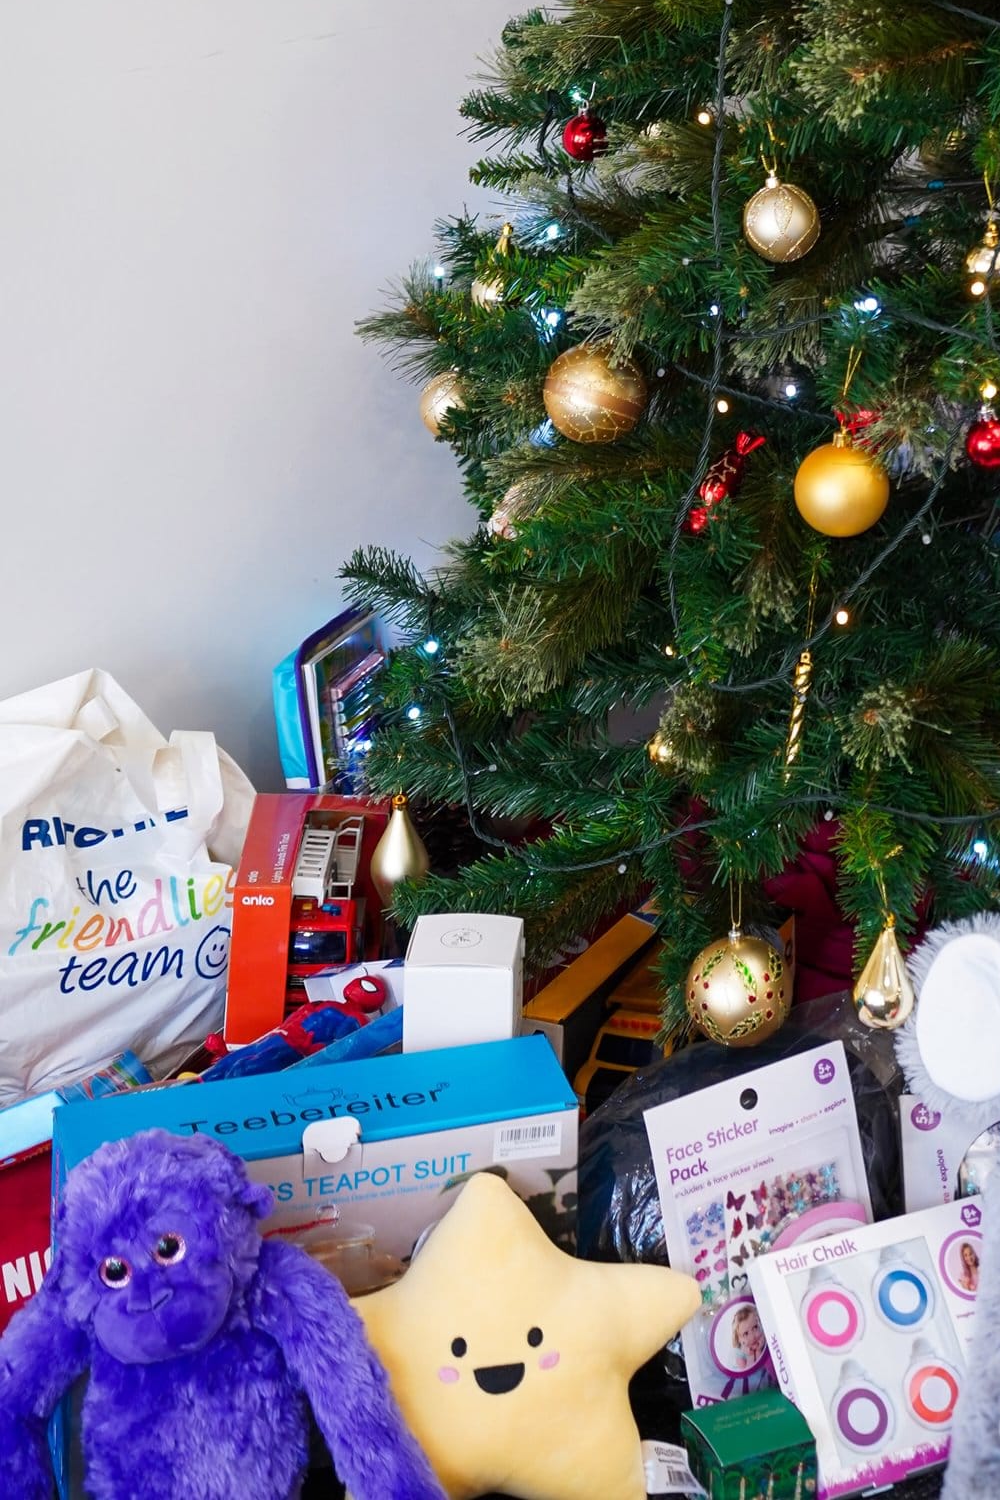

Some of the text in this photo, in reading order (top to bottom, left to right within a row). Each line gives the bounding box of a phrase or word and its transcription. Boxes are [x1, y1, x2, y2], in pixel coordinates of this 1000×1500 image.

[75, 870, 137, 906] the
[242, 895, 275, 906] anko
[59, 945, 184, 994] team
[824, 1097, 846, 1114] explore
[666, 1118, 759, 1164] Face Sticker
[304, 1164, 406, 1197] TEAPOT
[414, 1152, 472, 1180] SUIT
[670, 1158, 709, 1185] Pack
[776, 1238, 858, 1274] Hair Chalk
[770, 1333, 790, 1386] Chalk
